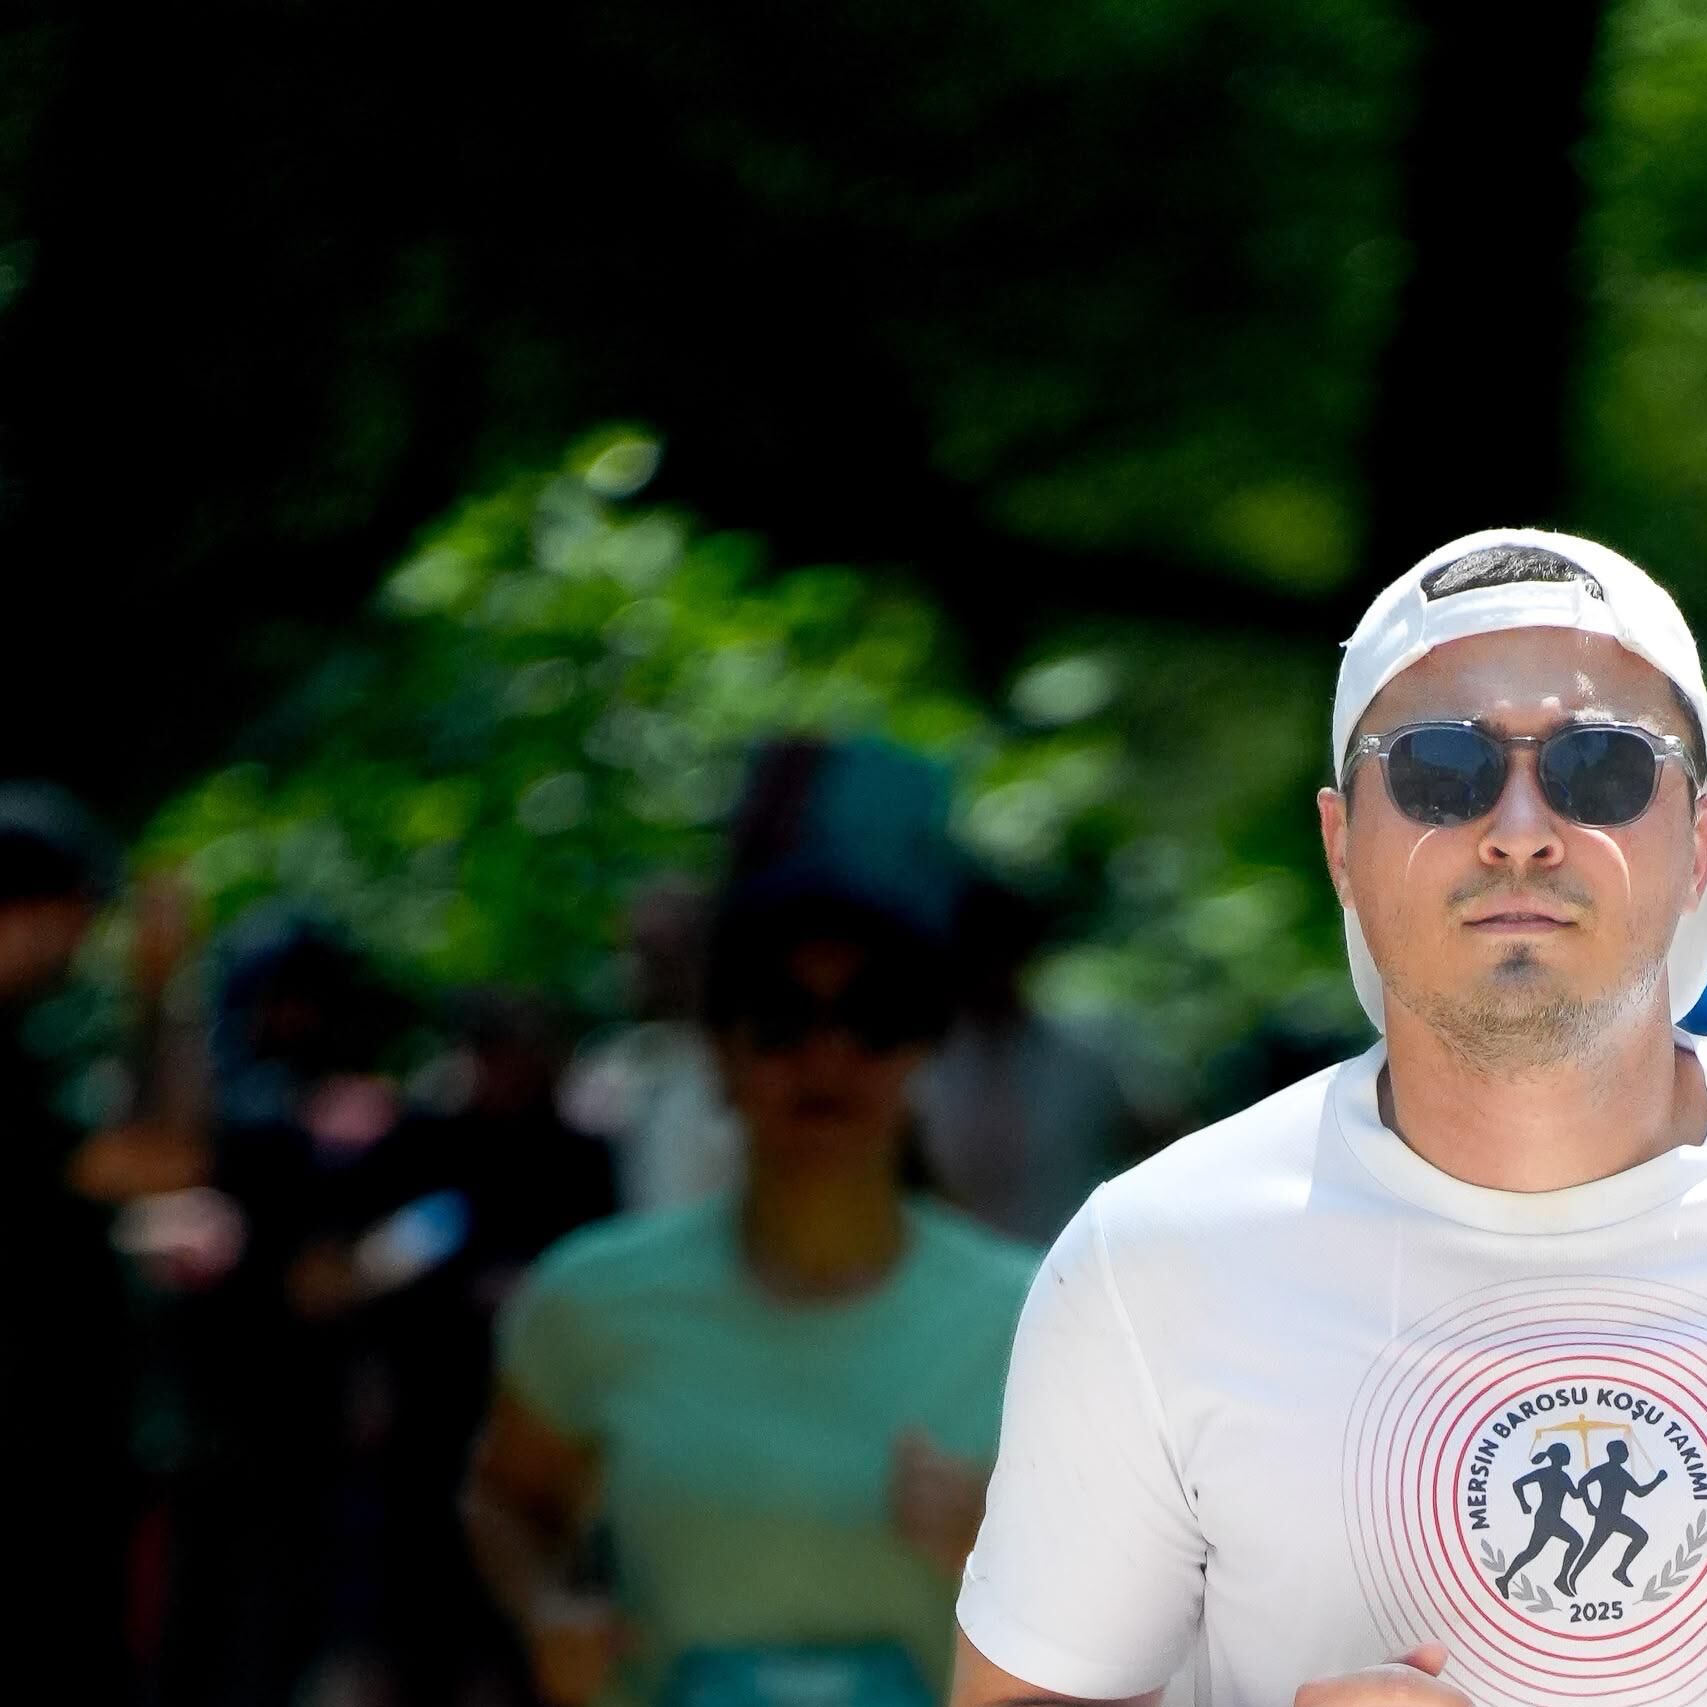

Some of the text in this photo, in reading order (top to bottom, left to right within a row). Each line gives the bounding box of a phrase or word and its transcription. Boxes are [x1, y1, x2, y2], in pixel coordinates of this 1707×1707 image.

[1492, 1386, 1588, 1439] BAROSU
[1597, 1387, 1665, 1426] KOŞU
[1569, 1600, 1624, 1623] 2025
